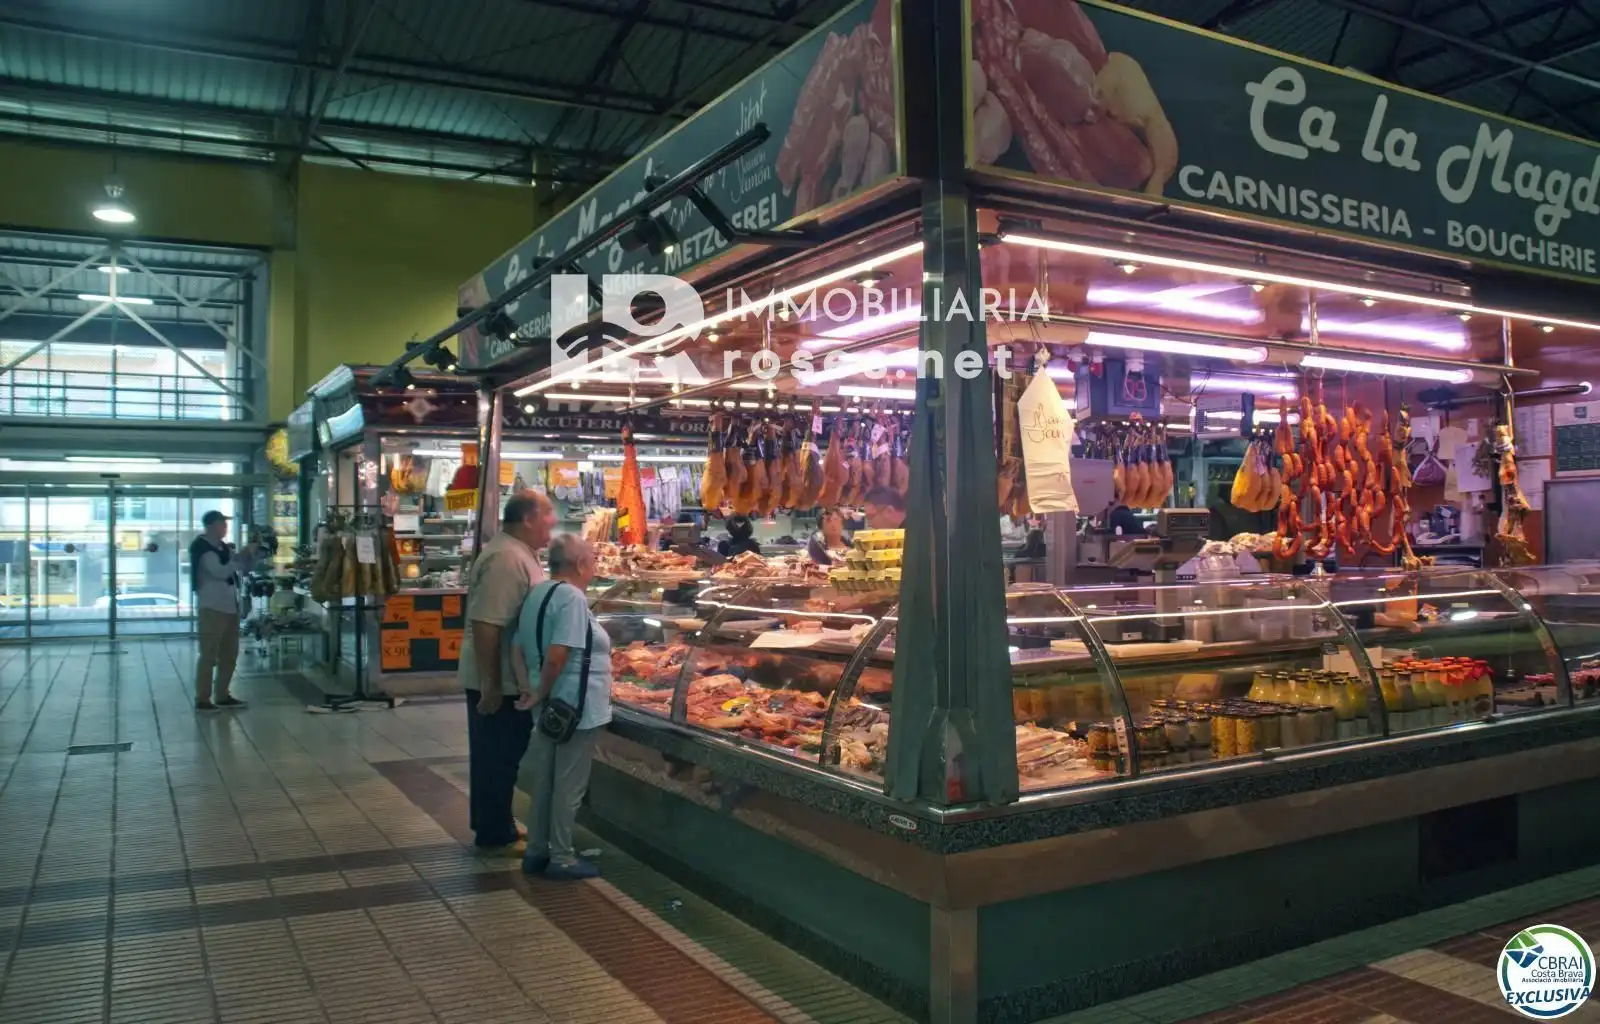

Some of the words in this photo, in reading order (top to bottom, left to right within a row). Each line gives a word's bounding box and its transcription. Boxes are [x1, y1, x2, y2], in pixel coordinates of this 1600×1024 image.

[1245, 66, 1340, 159] Ca
[1362, 94, 1421, 171] la
[1178, 165, 1412, 238] CARNISSERIA
[1447, 220, 1597, 273] BOUCHERIE
